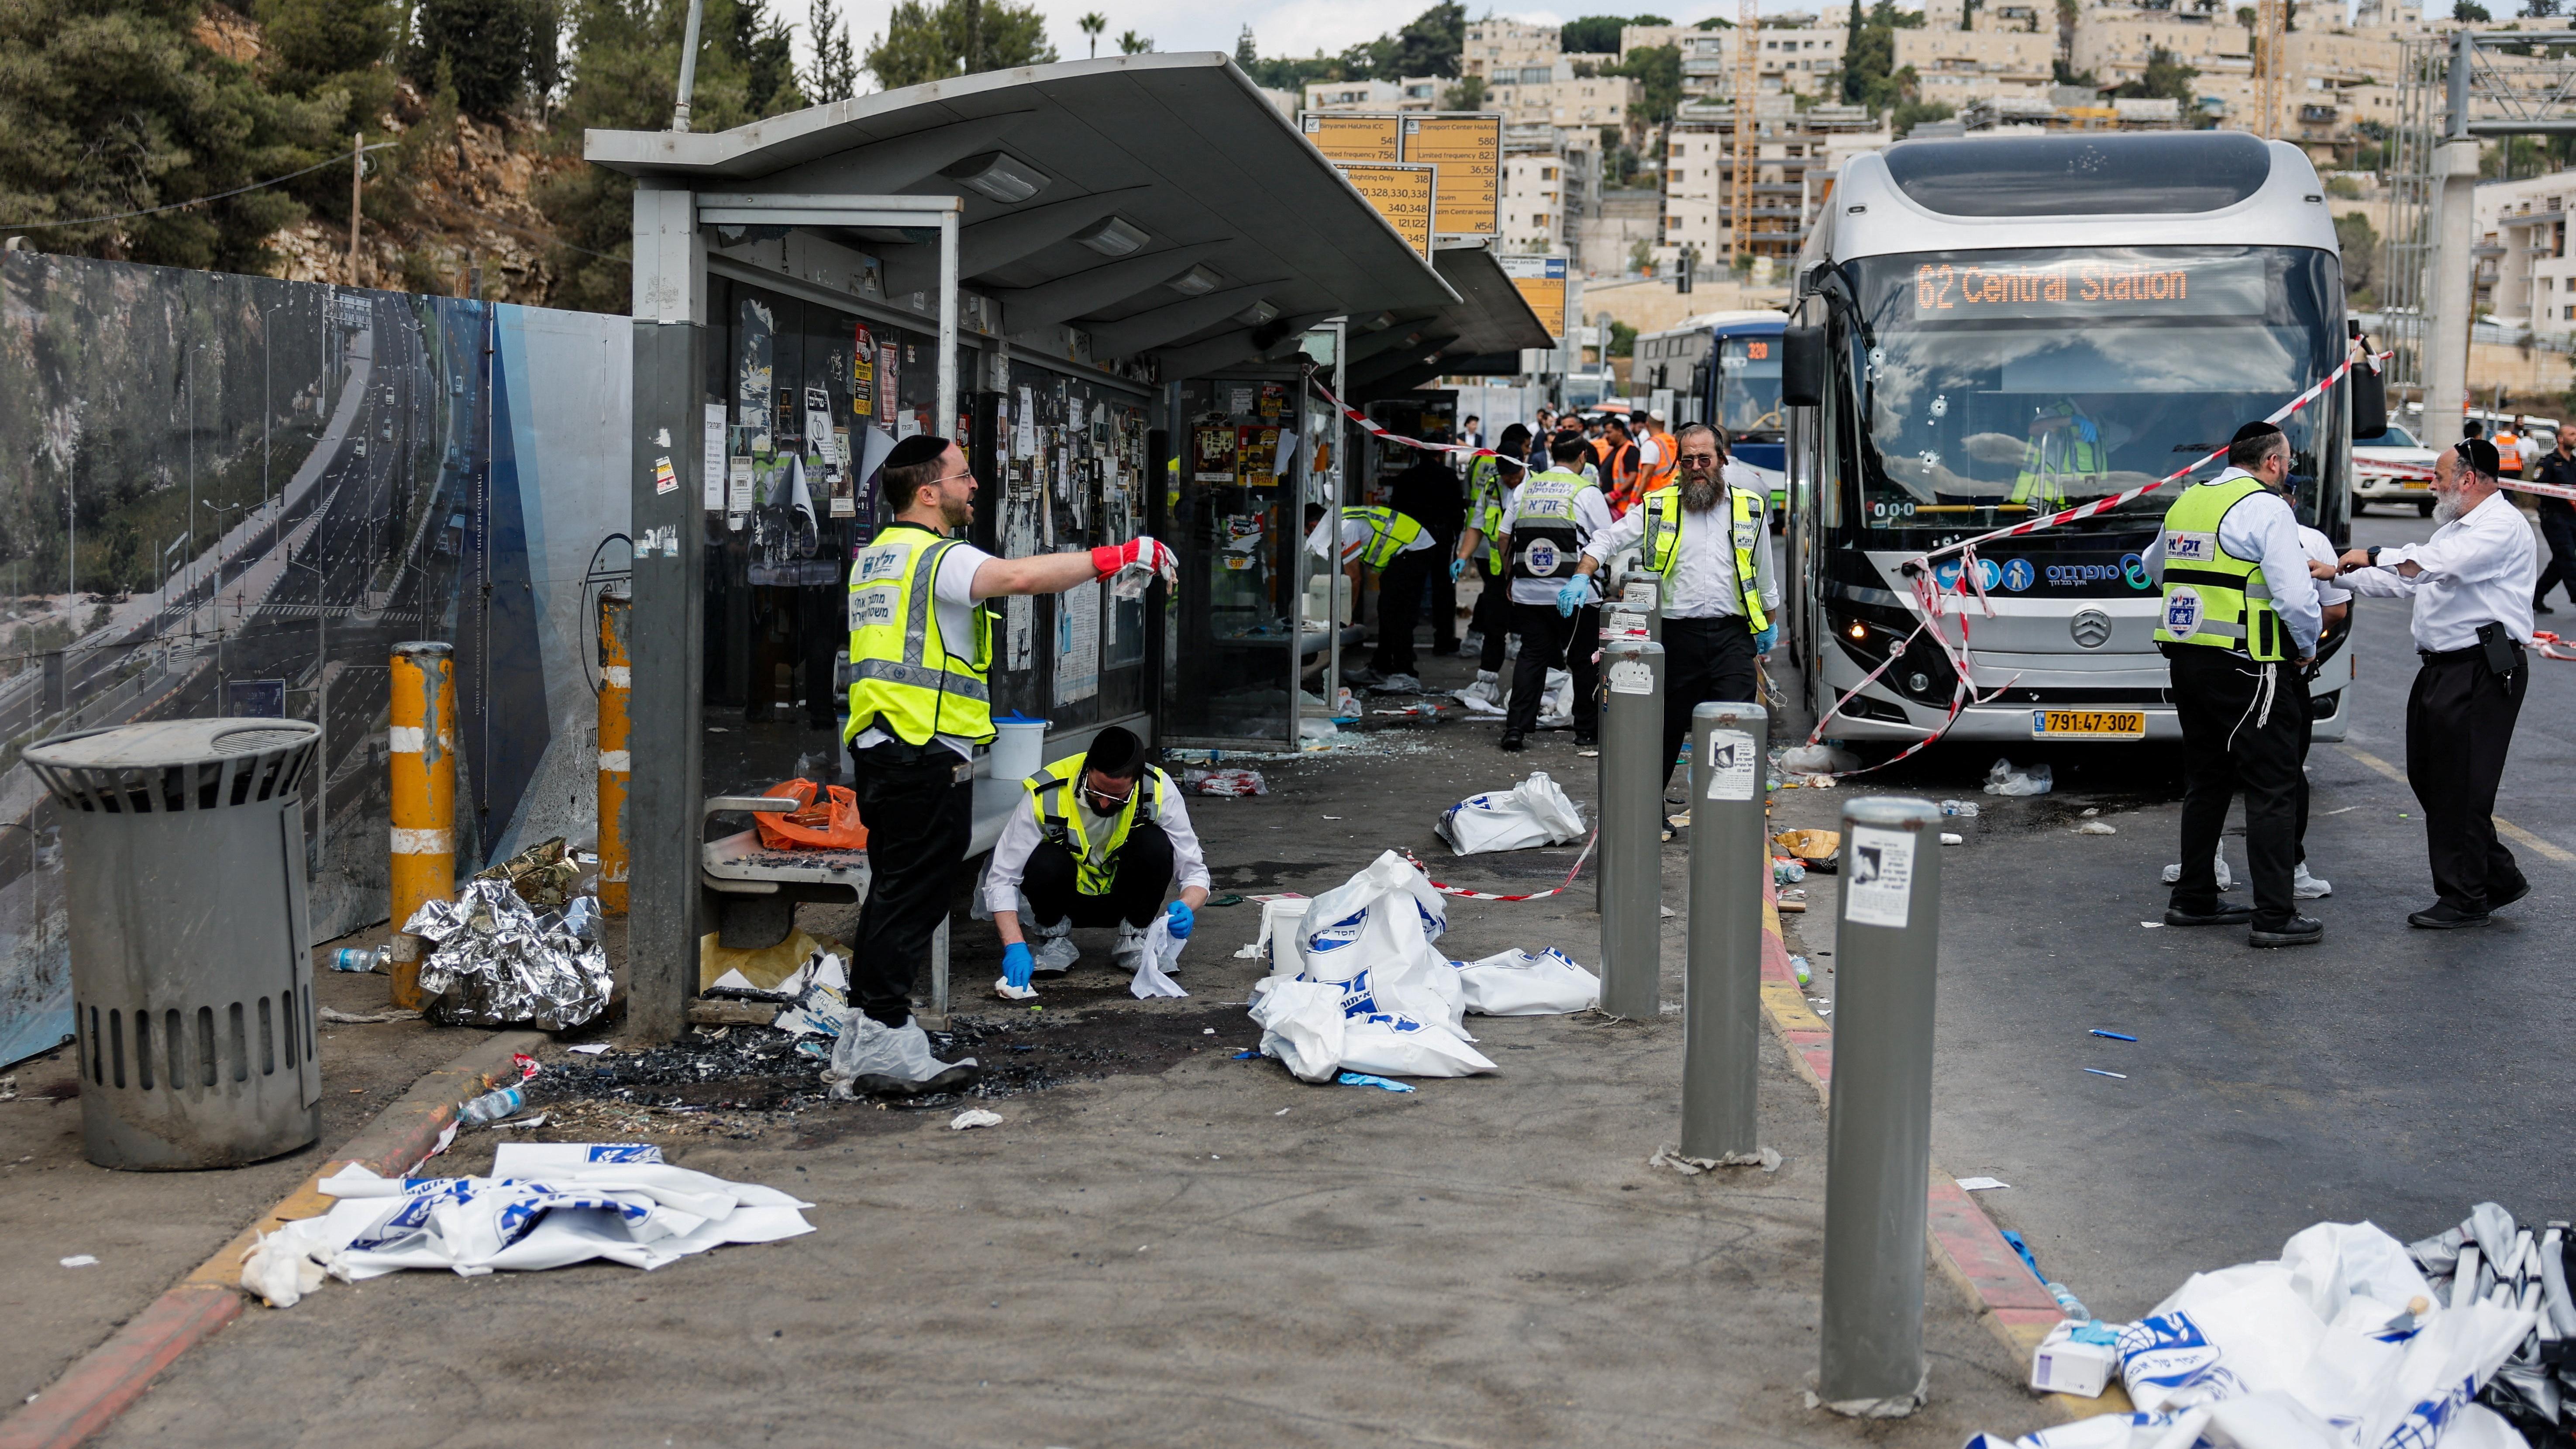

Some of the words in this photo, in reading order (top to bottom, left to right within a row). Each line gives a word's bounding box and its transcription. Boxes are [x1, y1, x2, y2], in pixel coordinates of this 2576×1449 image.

[1471, 166, 1495, 175] 36,56
[1388, 204, 1426, 214] 340,348
[1398, 219, 1426, 229] 121,122
[1918, 264, 1953, 308] 62
[1963, 263, 2067, 302] Central
[2080, 263, 2186, 300] Station
[1529, 499, 1559, 514] זק"א
[477, 511, 482, 522] אב
[2045, 565, 2120, 580] סופרבוס
[476, 676, 481, 688] של
[2051, 714, 2137, 731] 791-47-302
[2147, 1355, 2171, 1368] של
[2173, 1355, 2203, 1365] חסד
